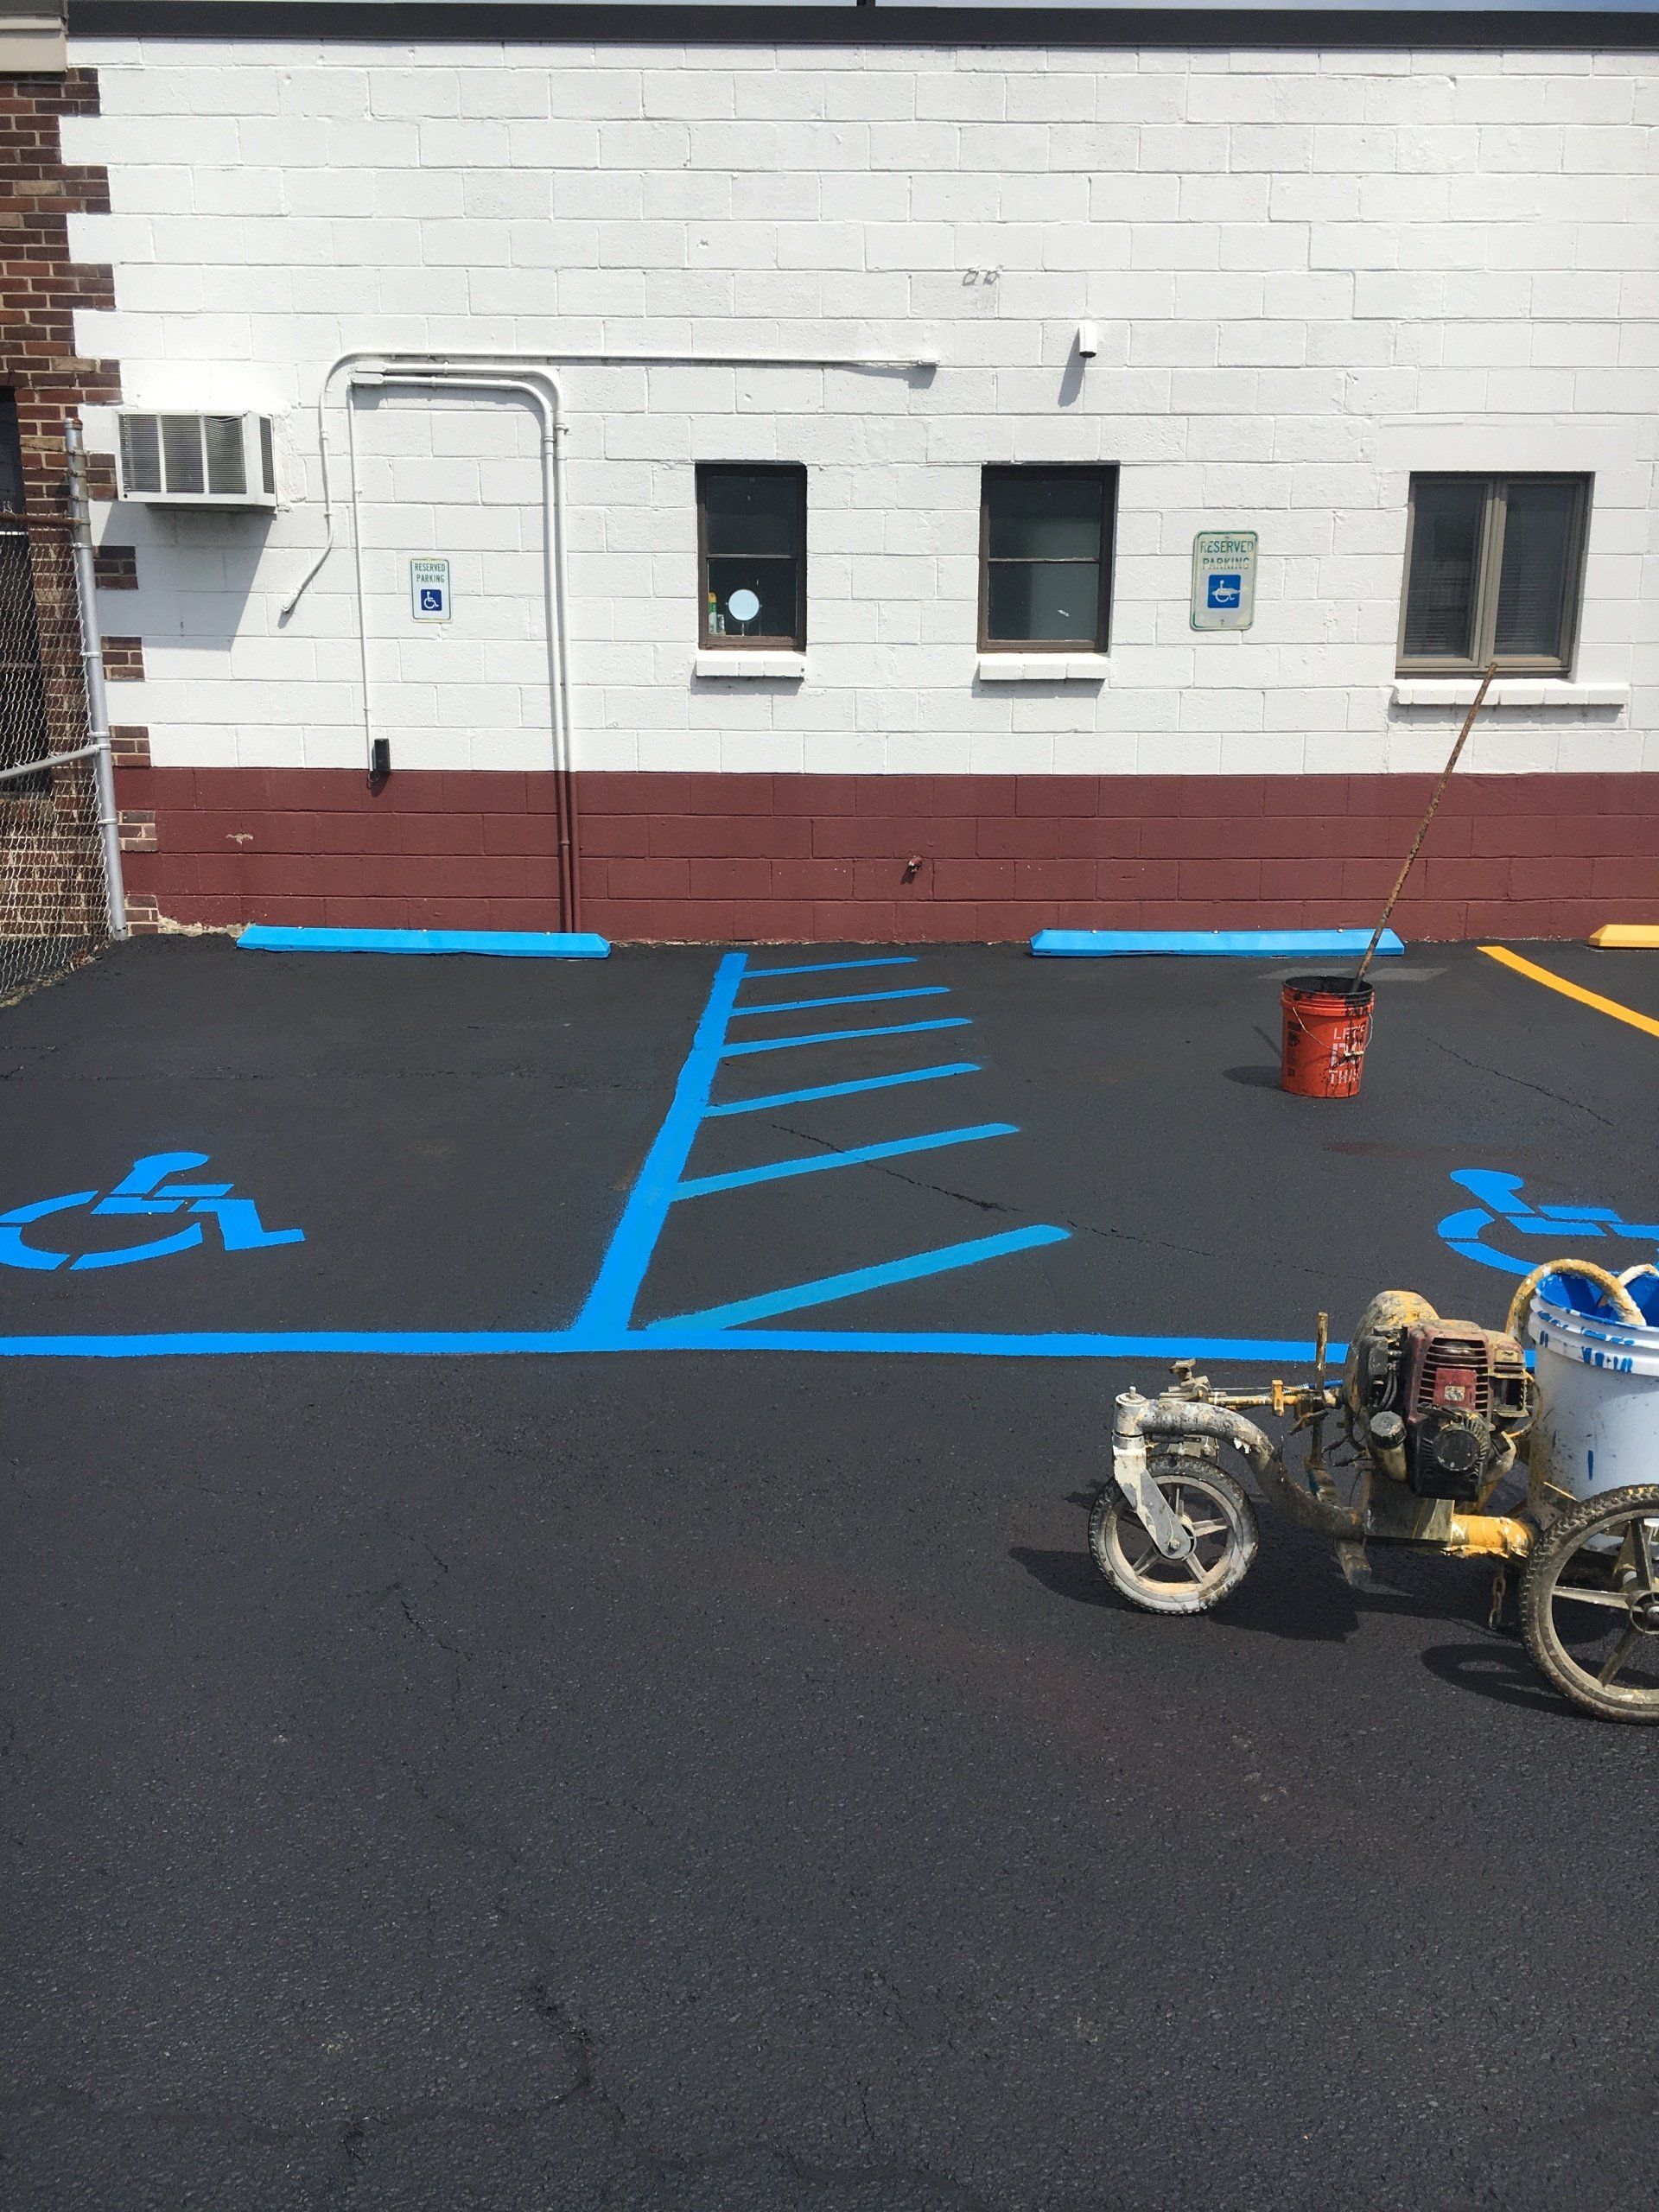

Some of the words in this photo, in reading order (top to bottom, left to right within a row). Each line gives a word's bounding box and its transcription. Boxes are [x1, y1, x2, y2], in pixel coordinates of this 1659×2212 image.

[1200, 540, 1254, 553] RESERVED
[415, 563, 446, 572] RESERVED
[416, 574, 445, 583] PARKING
